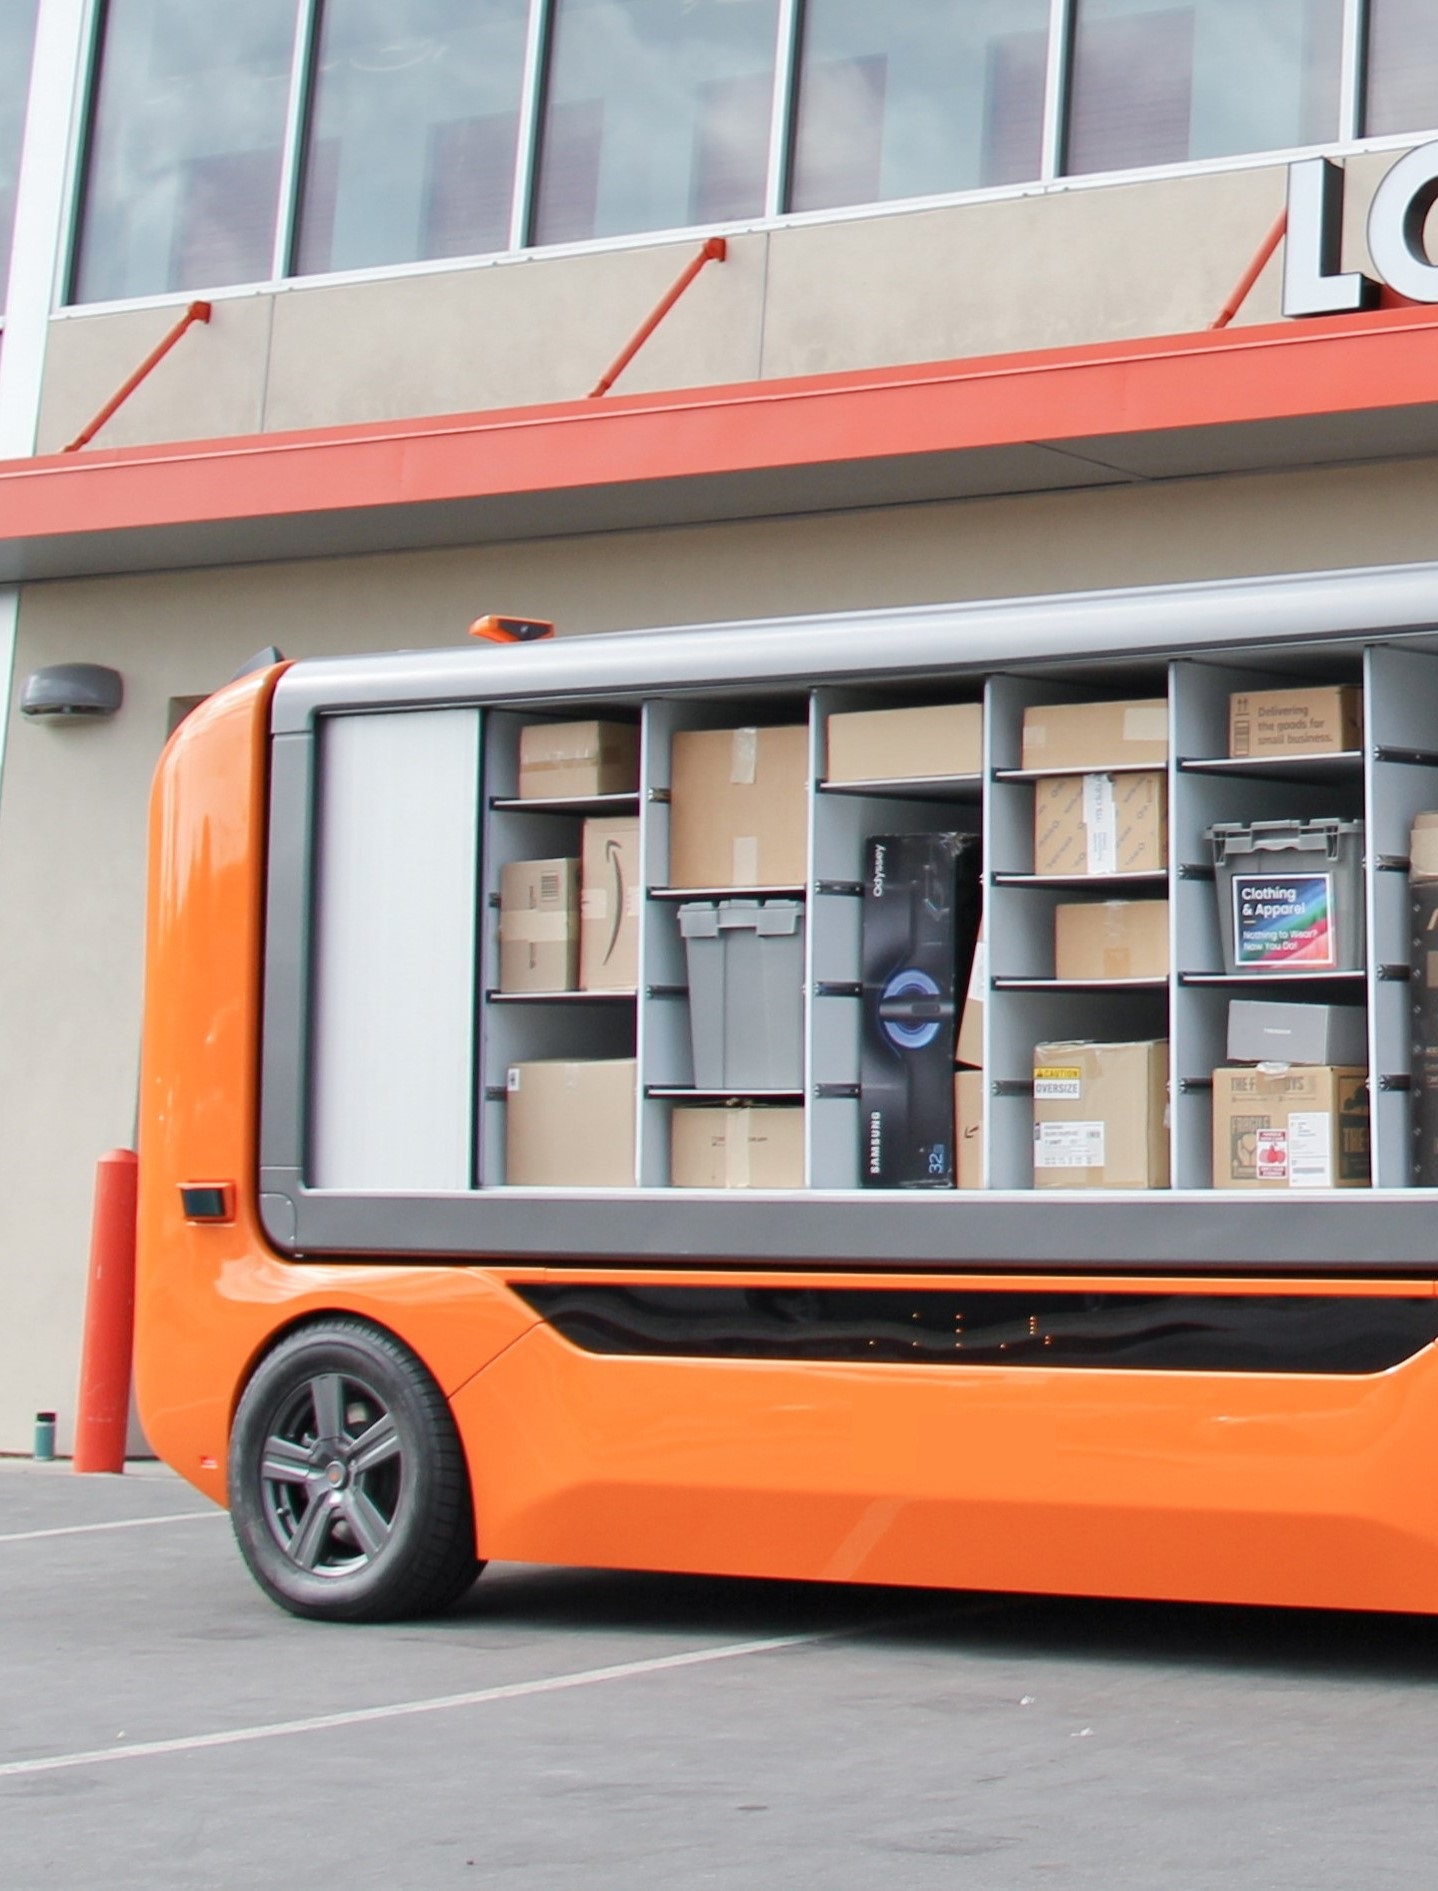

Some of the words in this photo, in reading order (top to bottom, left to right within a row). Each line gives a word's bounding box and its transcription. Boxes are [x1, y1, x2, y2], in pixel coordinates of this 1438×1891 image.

[1258, 706, 1308, 717] Delivering
[1258, 721, 1274, 731] the
[1277, 720, 1308, 732] goods
[1310, 718, 1325, 729] for
[1258, 735, 1285, 745] small
[873, 843, 886, 897] Odyssey
[1241, 886, 1297, 903] Clothing
[1242, 903, 1253, 916] &
[1255, 902, 1306, 918] Apparel
[1243, 931, 1278, 941] Nothing
[1279, 930, 1289, 939] to
[1290, 929, 1319, 939] Wear?
[1243, 942, 1263, 951] Now
[1265, 942, 1281, 951] You
[1036, 1083, 1078, 1094] OVERSIZE
[870, 1111, 881, 1174] SAMSUNG
